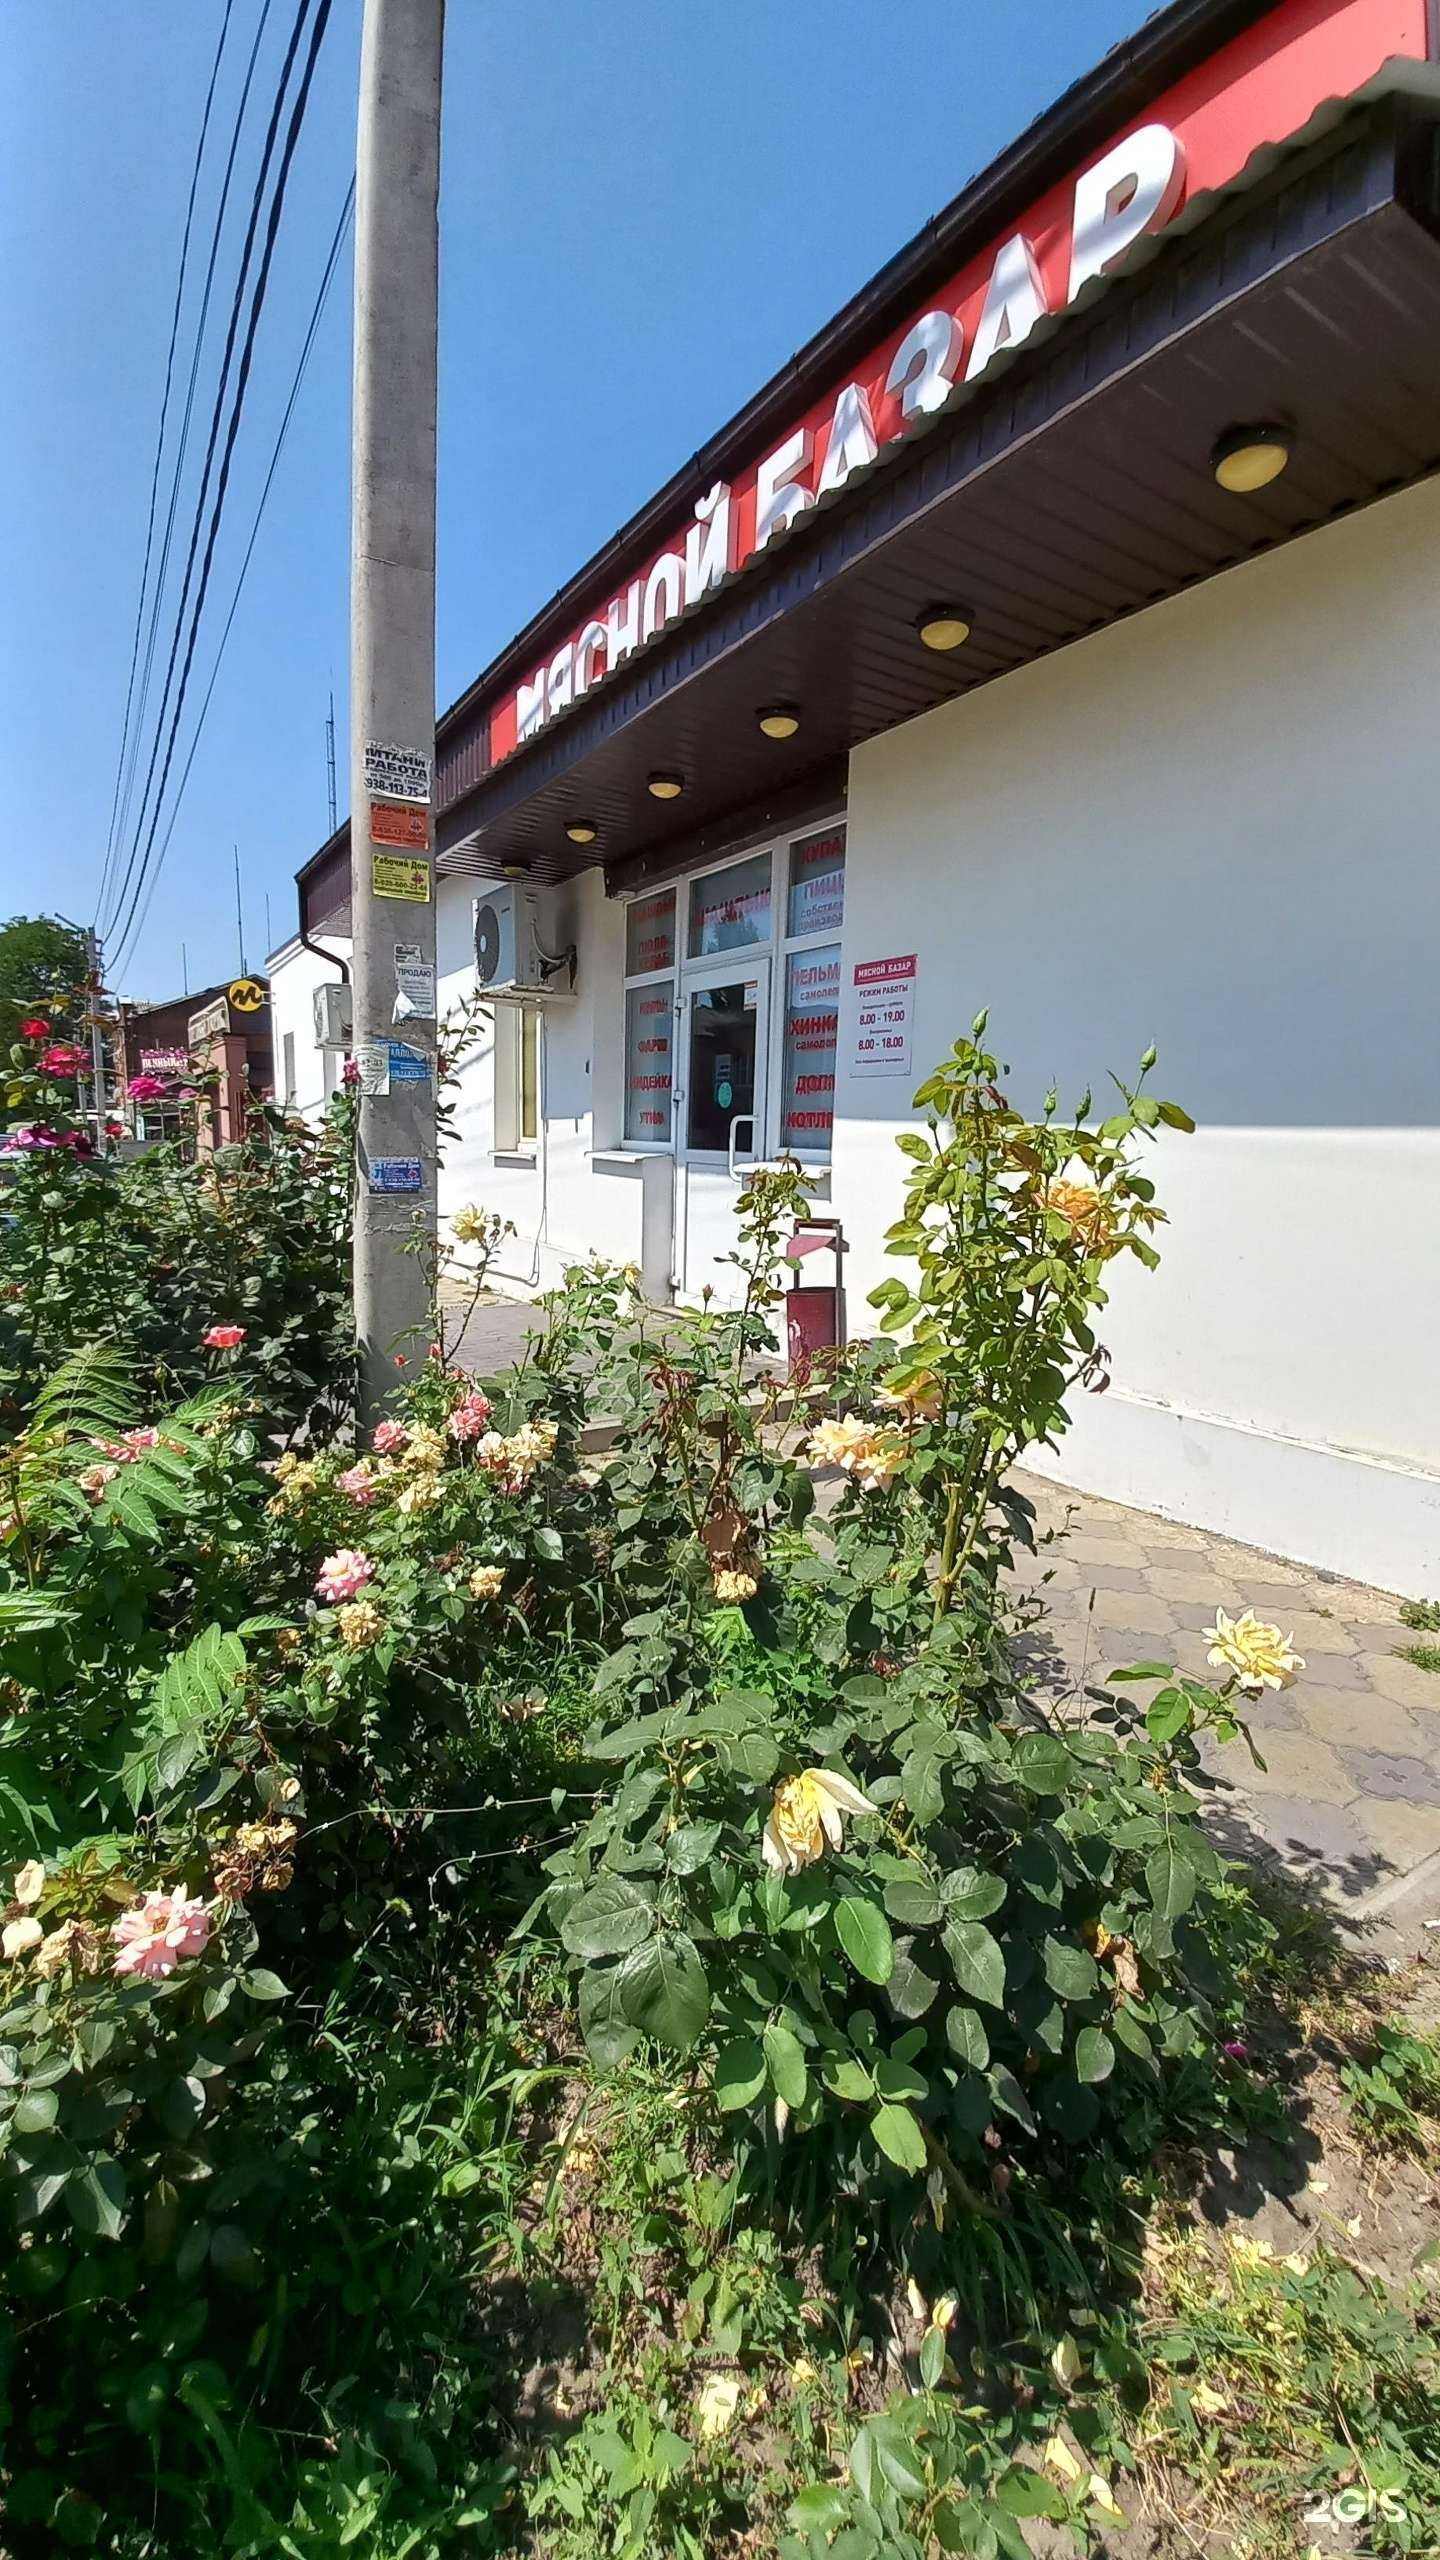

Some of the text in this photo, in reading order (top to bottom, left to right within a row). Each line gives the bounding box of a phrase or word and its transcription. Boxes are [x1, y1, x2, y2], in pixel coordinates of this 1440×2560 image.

[515, 122, 1187, 743] МЯСНОЙ БАЗАР
[365, 757, 427, 778] РАБОТА
[373, 855, 428, 870] Рабочий Дом
[398, 968, 432, 977] ПРОДАЮ
[857, 961, 912, 978] МЯСНОЙ БАЗАР
[882, 984, 909, 995] РАБОТЫ
[859, 1013, 876, 1026] 8.00
[884, 1010, 905, 1023] 19.00
[858, 1039, 875, 1051] 8.00
[882, 1036, 903, 1049] 18.00
